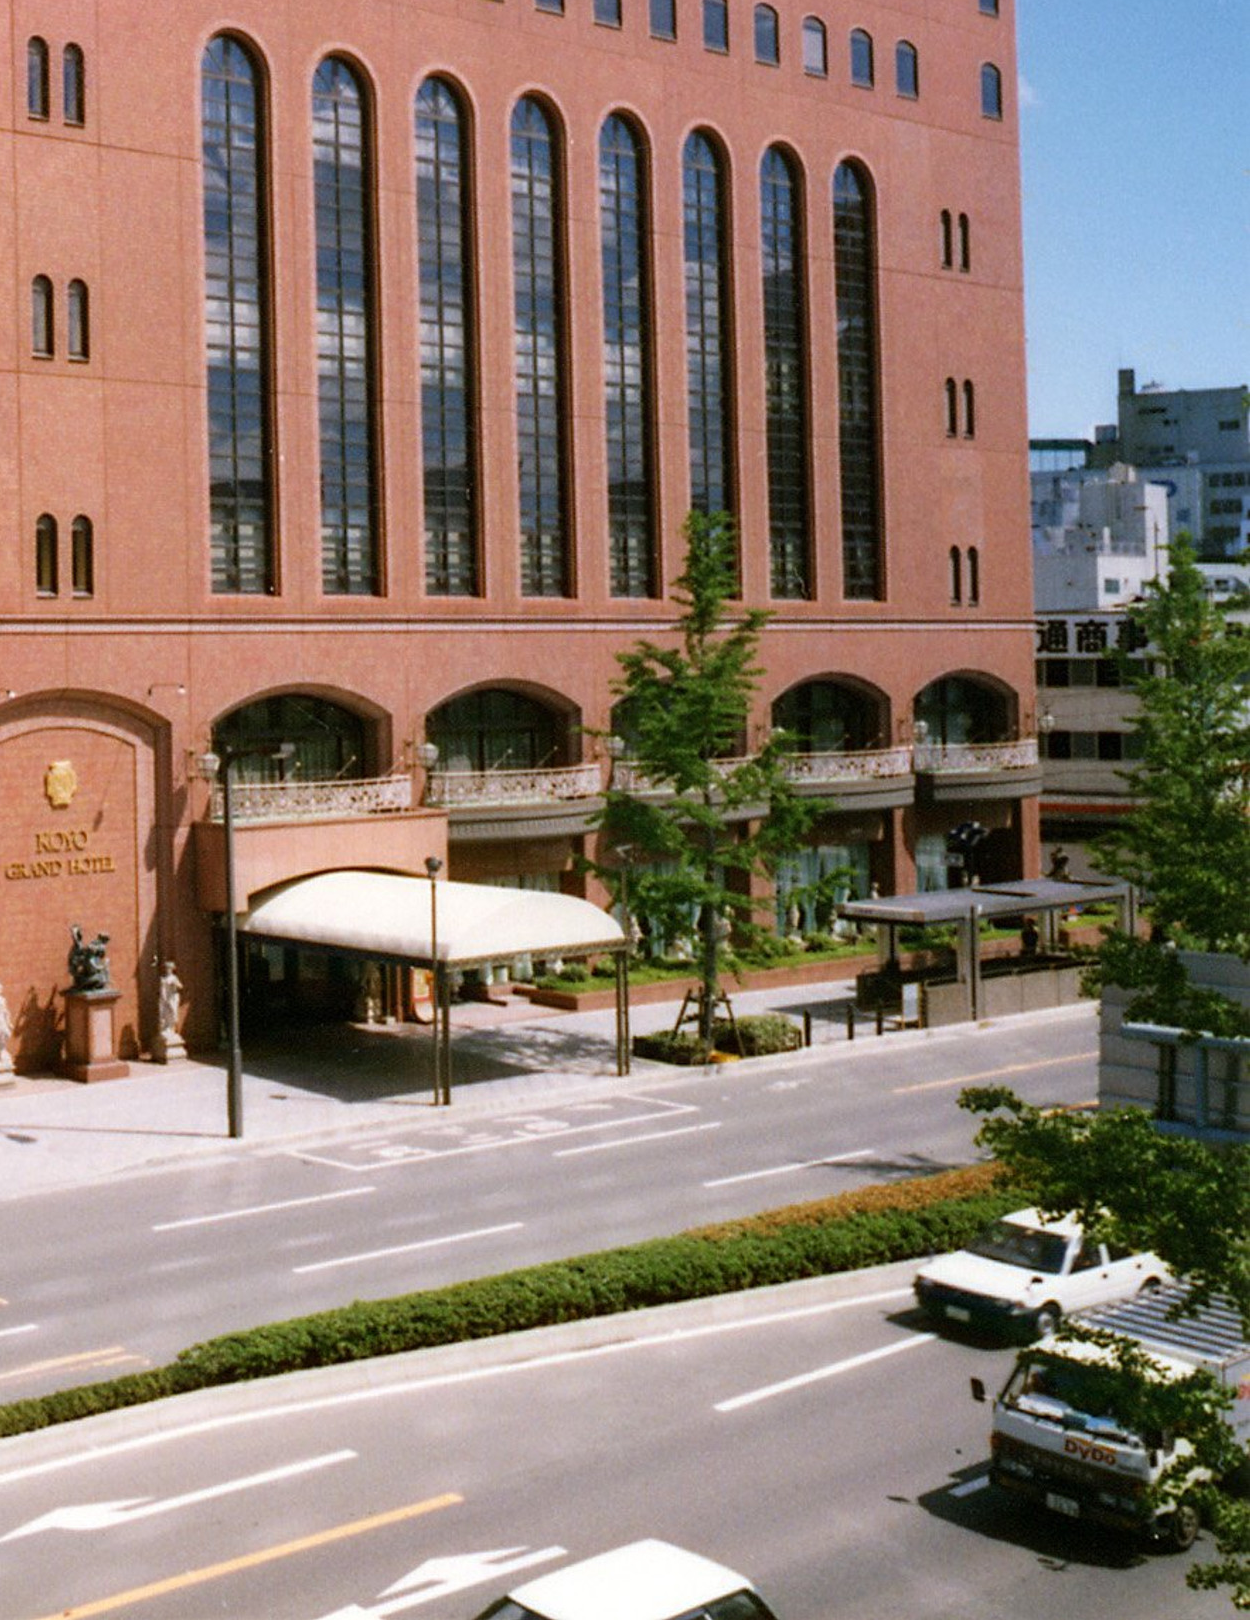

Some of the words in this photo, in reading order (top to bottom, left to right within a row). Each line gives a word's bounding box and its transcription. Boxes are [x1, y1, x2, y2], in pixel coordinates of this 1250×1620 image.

[35, 831, 88, 854] KOYO
[5, 860, 63, 880] GRAND
[68, 856, 116, 876] HOTEL
